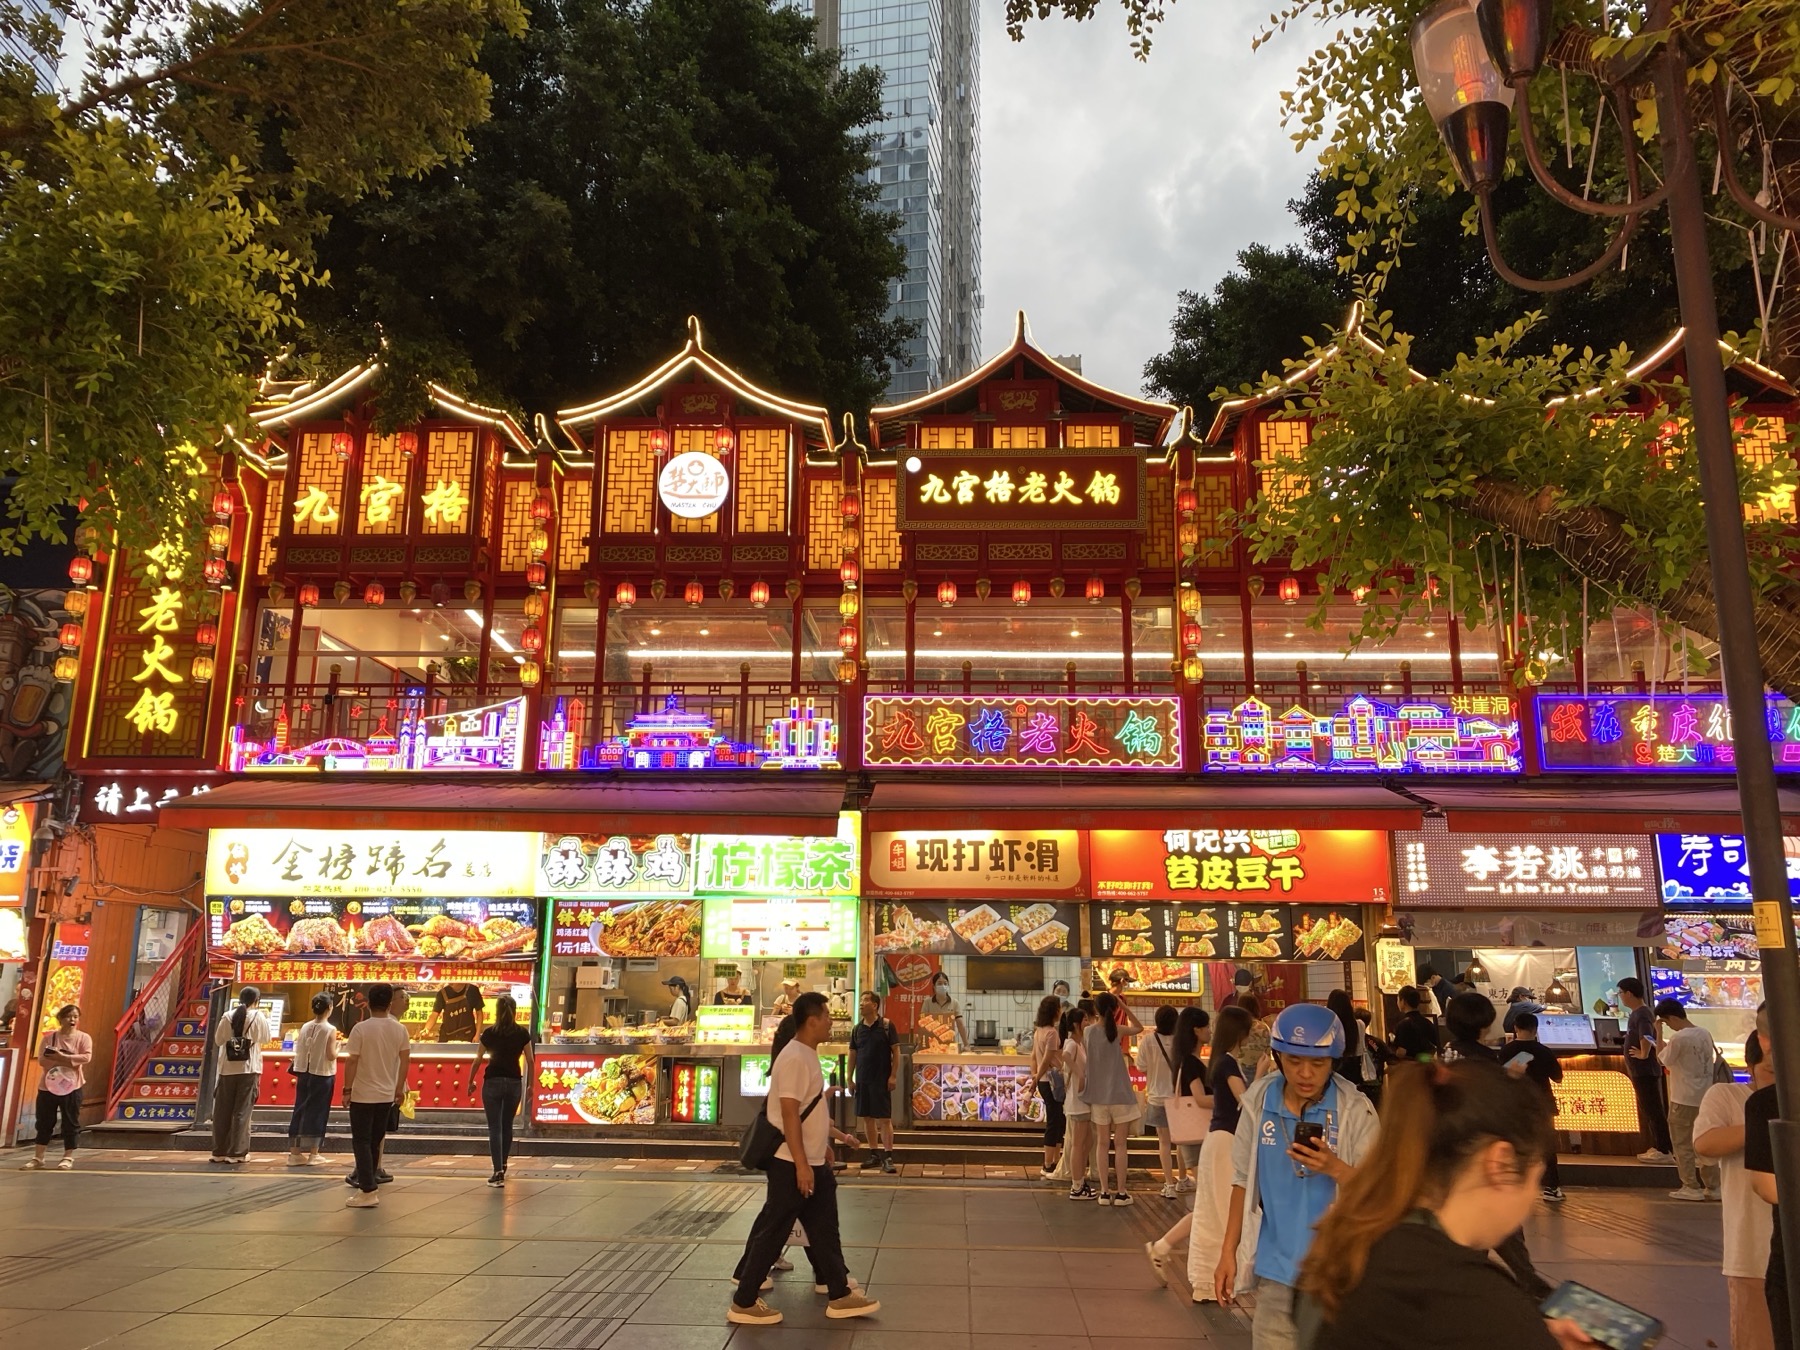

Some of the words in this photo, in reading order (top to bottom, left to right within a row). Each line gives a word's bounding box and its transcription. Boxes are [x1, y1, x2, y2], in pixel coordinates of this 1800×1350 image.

[294, 476, 468, 524] 九宫格
[921, 470, 1121, 505] 九宫格老火锅
[1452, 696, 1509, 715] 洪崖洞
[882, 707, 1162, 757] 九宫格老火锅
[272, 837, 452, 886] 金榜蹄名
[547, 840, 685, 887] 钵钵鸡
[709, 840, 853, 888] 柠檬茶
[916, 838, 1060, 872] 现打虾滑
[1461, 845, 1587, 880] 李若桃
[1165, 857, 1304, 891] 苕皮豆干
[556, 908, 616, 928] 钵钵鸡
